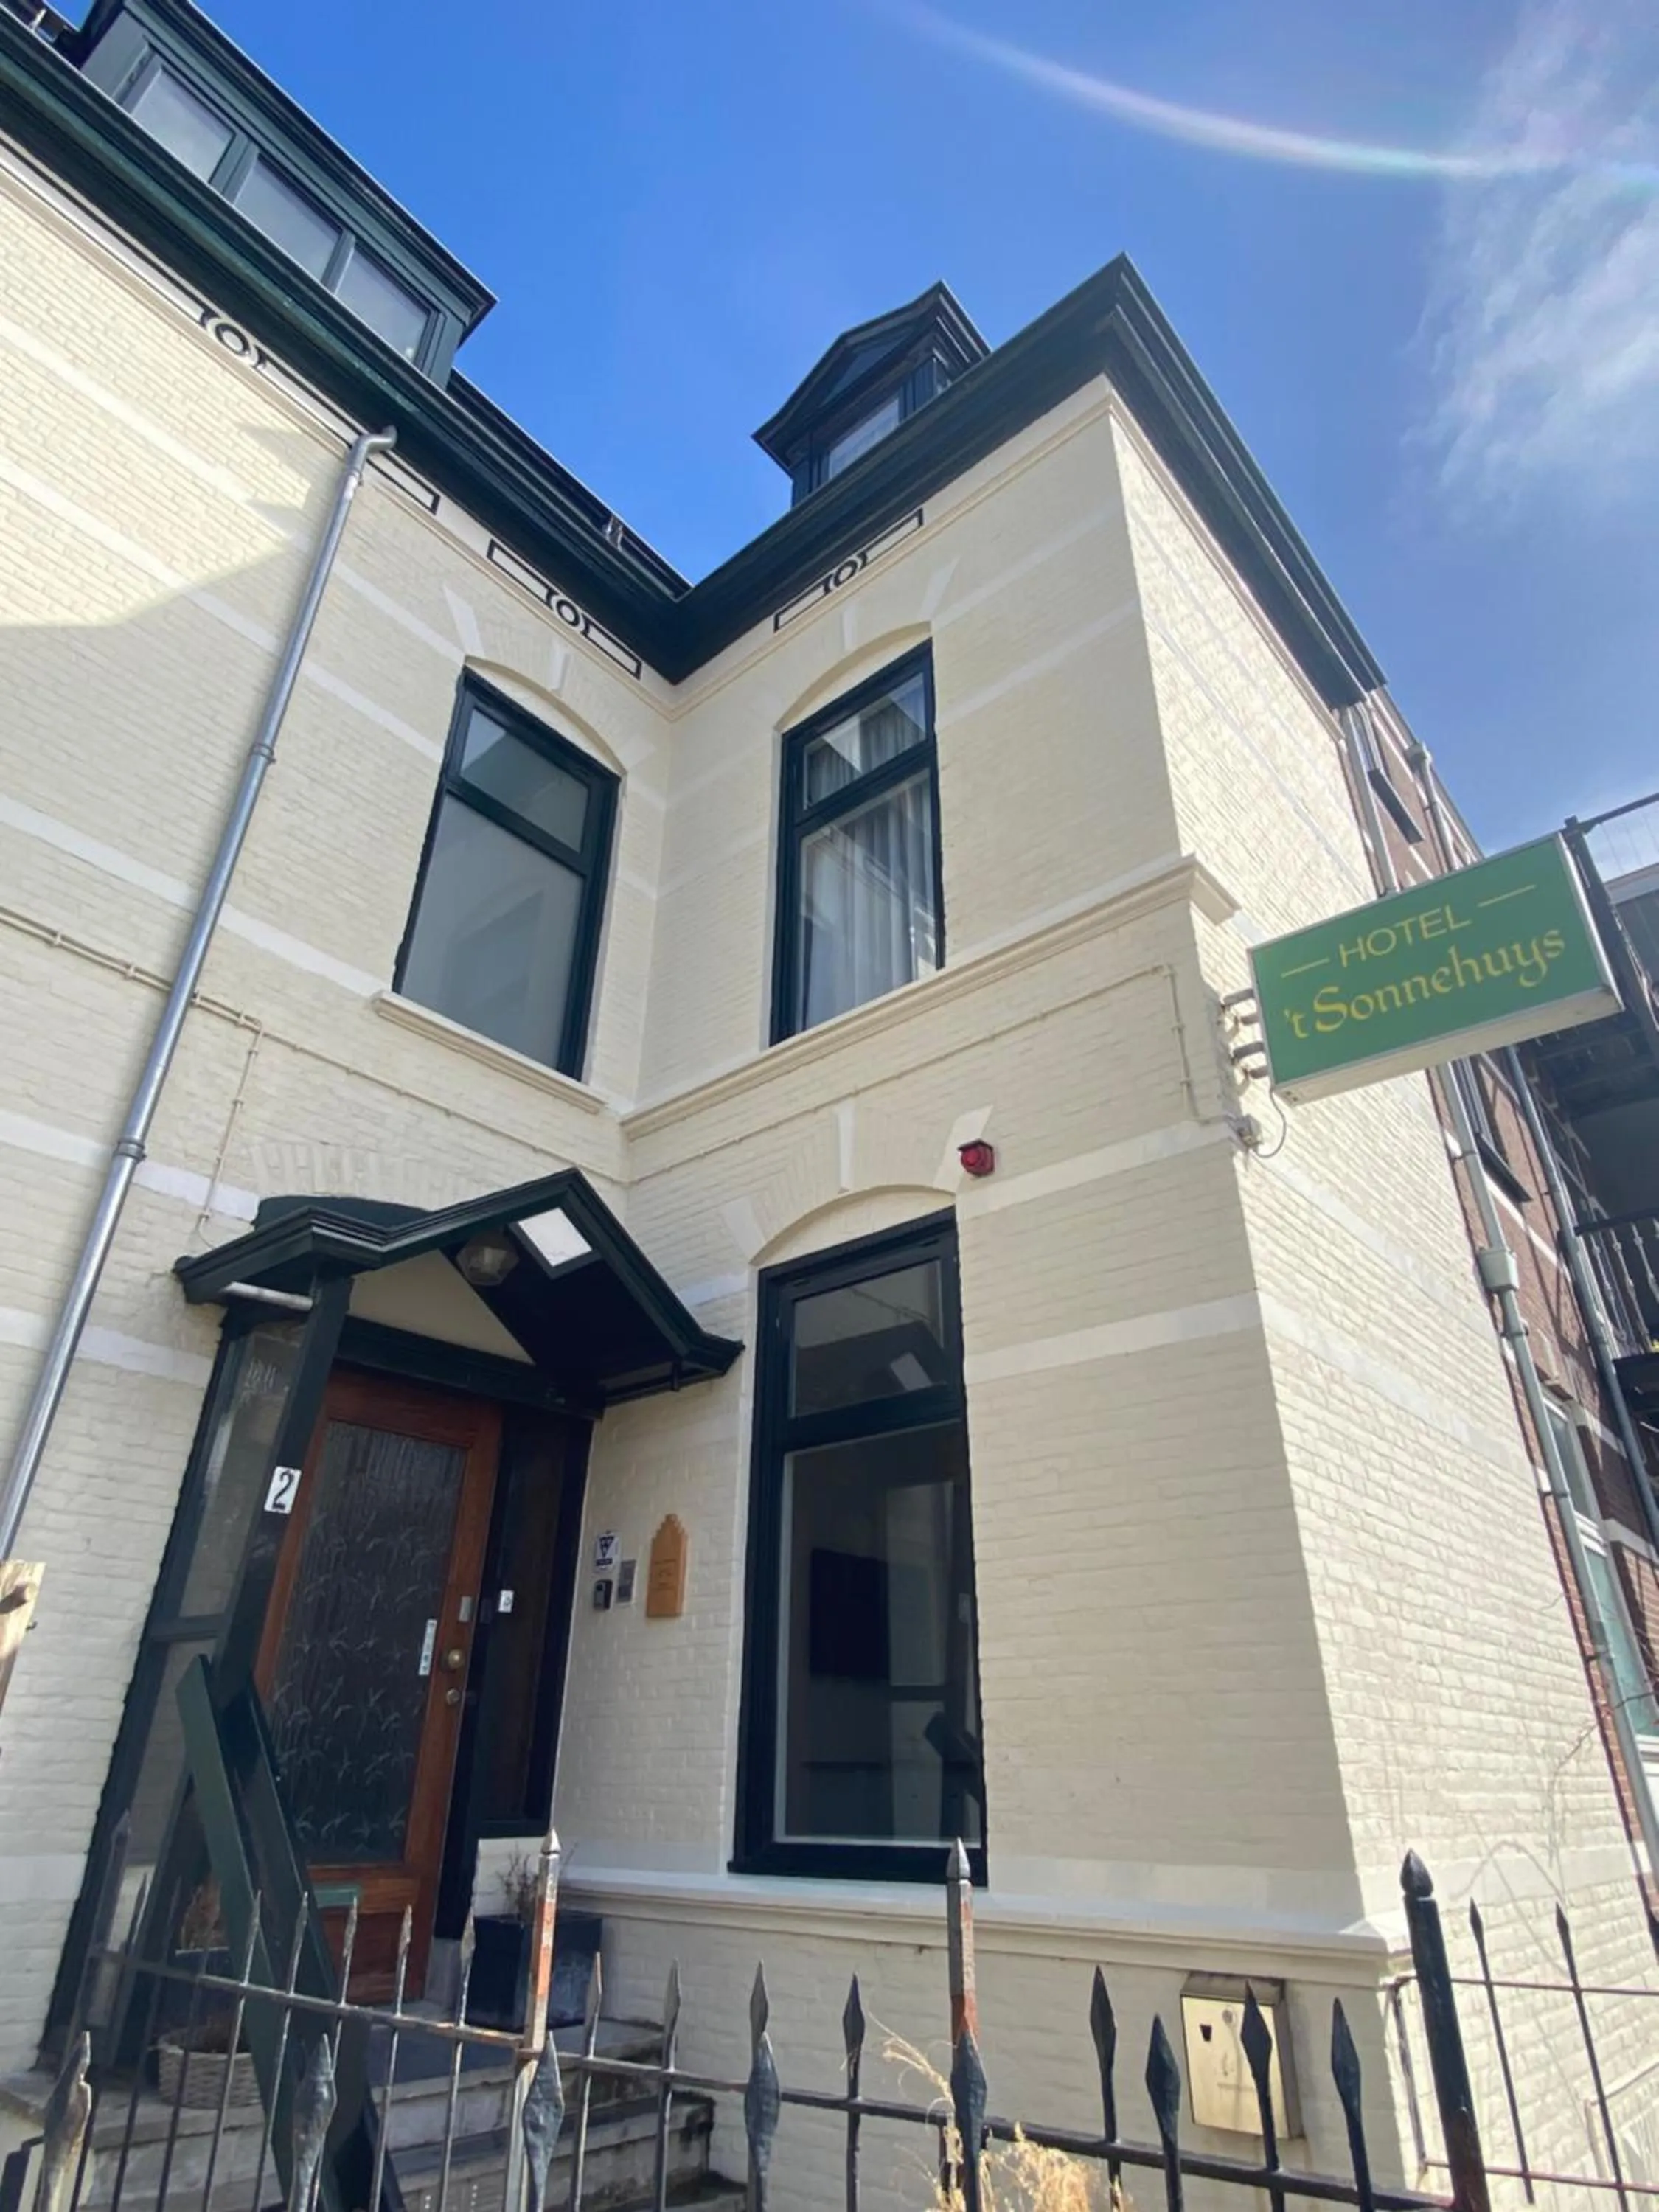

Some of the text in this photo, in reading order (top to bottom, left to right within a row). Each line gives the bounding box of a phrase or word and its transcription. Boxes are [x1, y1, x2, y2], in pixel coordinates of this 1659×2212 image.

[1338, 905, 1471, 967] HOTEL
[1312, 929, 1565, 1032] Sonnehuys
[271, 1469, 294, 1510] 2
